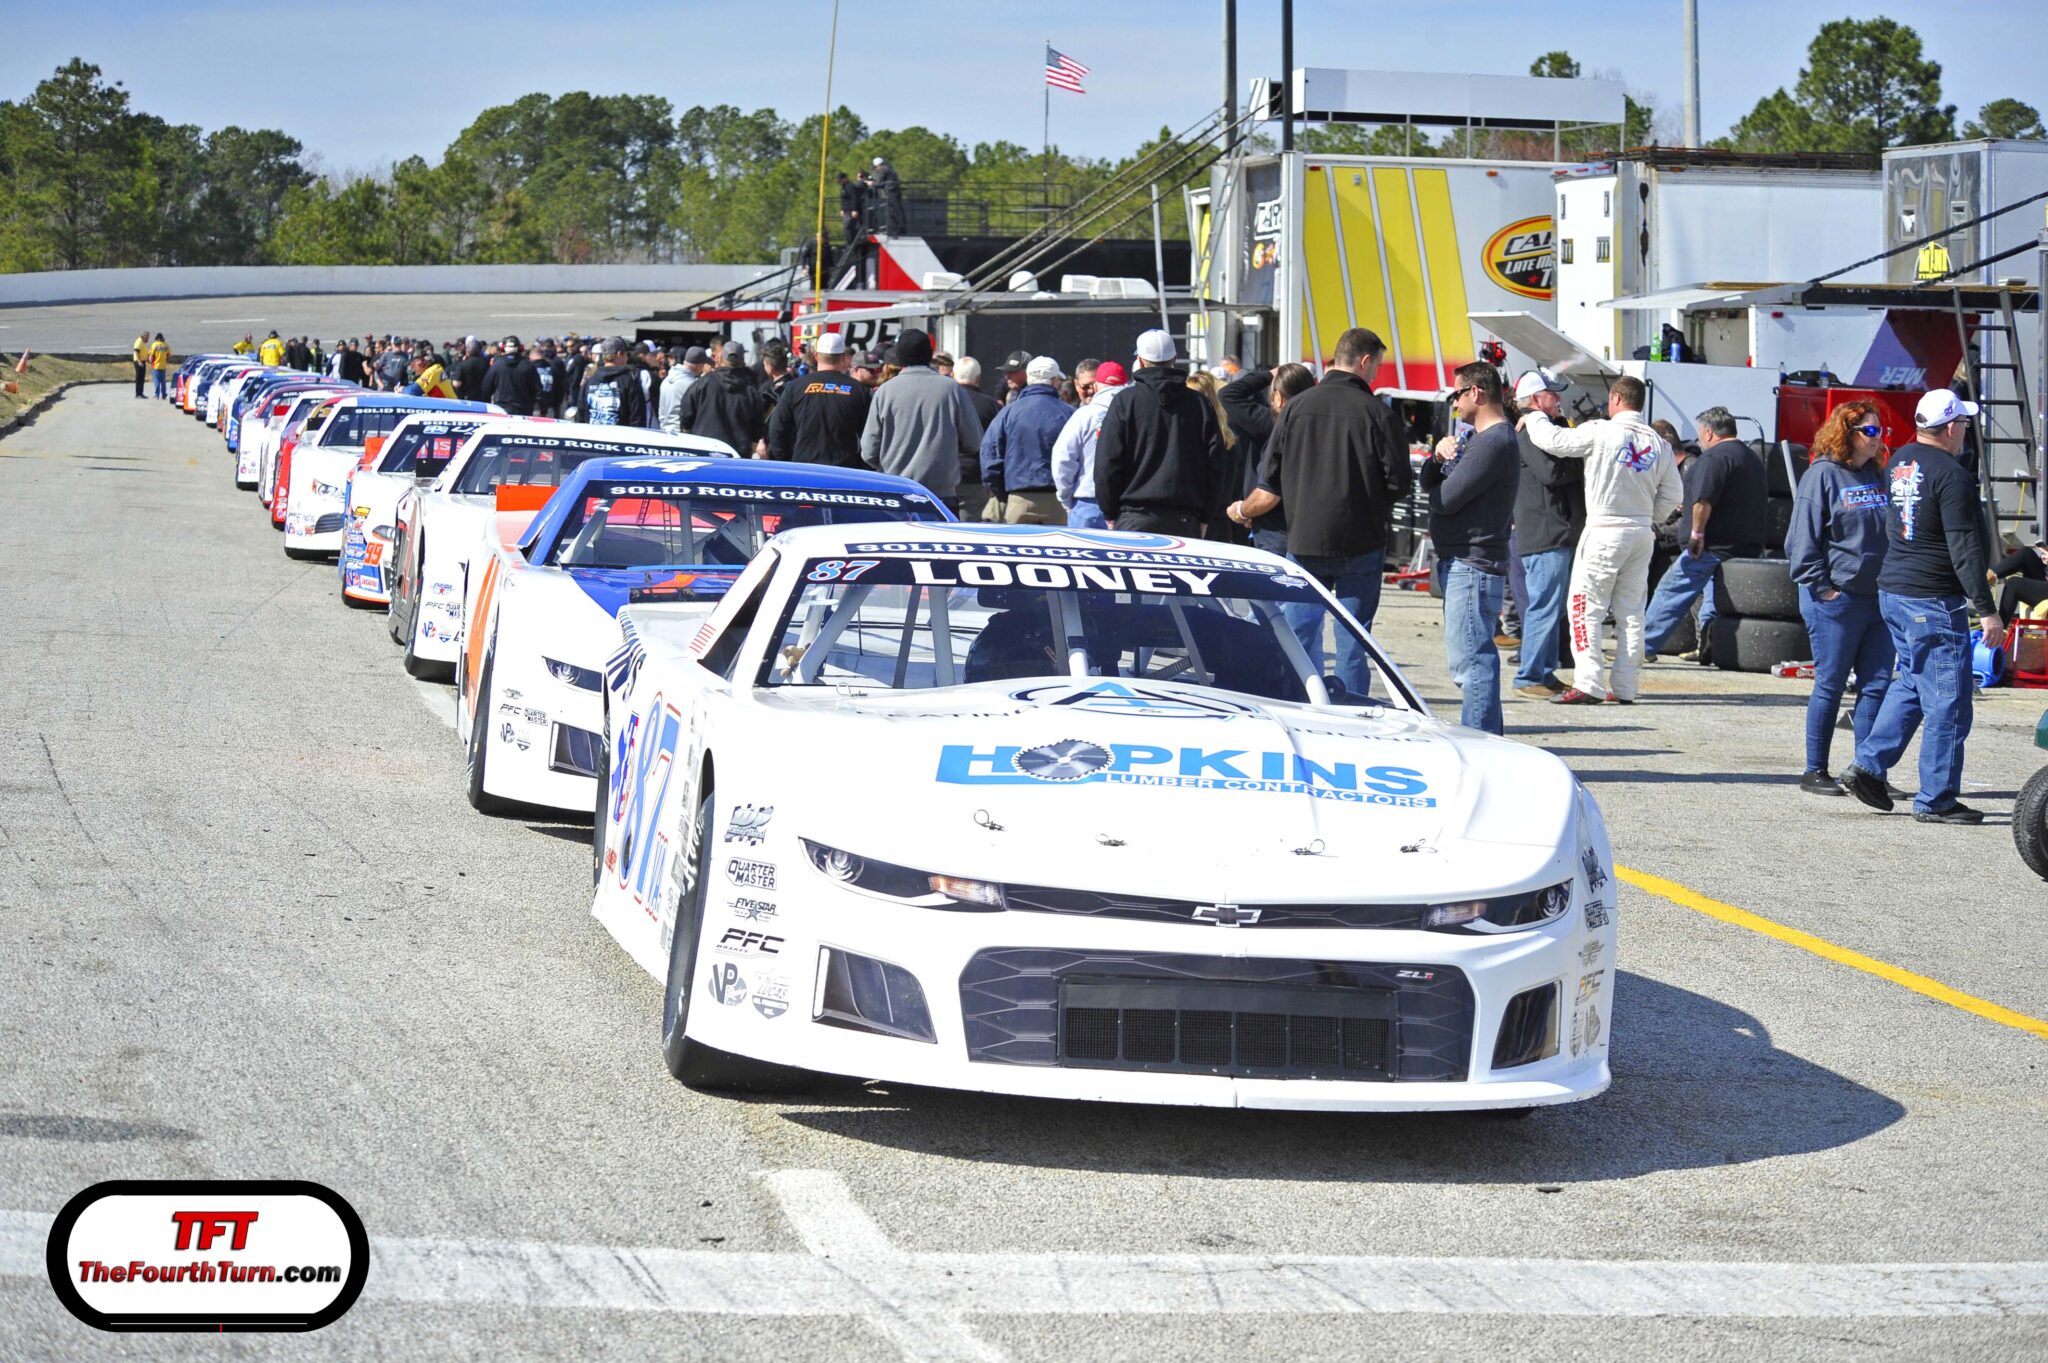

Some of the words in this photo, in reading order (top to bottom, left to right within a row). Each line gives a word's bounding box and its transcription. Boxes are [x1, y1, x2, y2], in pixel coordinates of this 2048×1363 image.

[1505, 258, 1537, 275] LATE
[501, 437, 560, 446] SOLID
[564, 440, 621, 451] ROCK
[610, 486, 691, 496] SOLID
[697, 487, 775, 499] ROCK
[780, 491, 901, 508] CARRIERS
[364, 542, 384, 566] 99
[855, 542, 975, 555] SOLID
[986, 546, 1099, 559] ROCK
[1106, 551, 1278, 574] CARRIERS
[806, 559, 882, 582] 87
[909, 560, 1220, 596] LOONEY
[500, 703, 522, 715] PFC
[501, 722, 512, 743] VP
[1105, 773, 1214, 789] LUMBER
[1223, 780, 1429, 808] CONTRACTORS
[728, 859, 775, 877] QUARTER
[735, 871, 776, 888] MASTER
[736, 897, 755, 909] FIVE
[757, 901, 777, 914] STAR
[720, 927, 785, 954] PFC
[712, 962, 738, 1005] VP
[1396, 969, 1434, 980] ZL1
